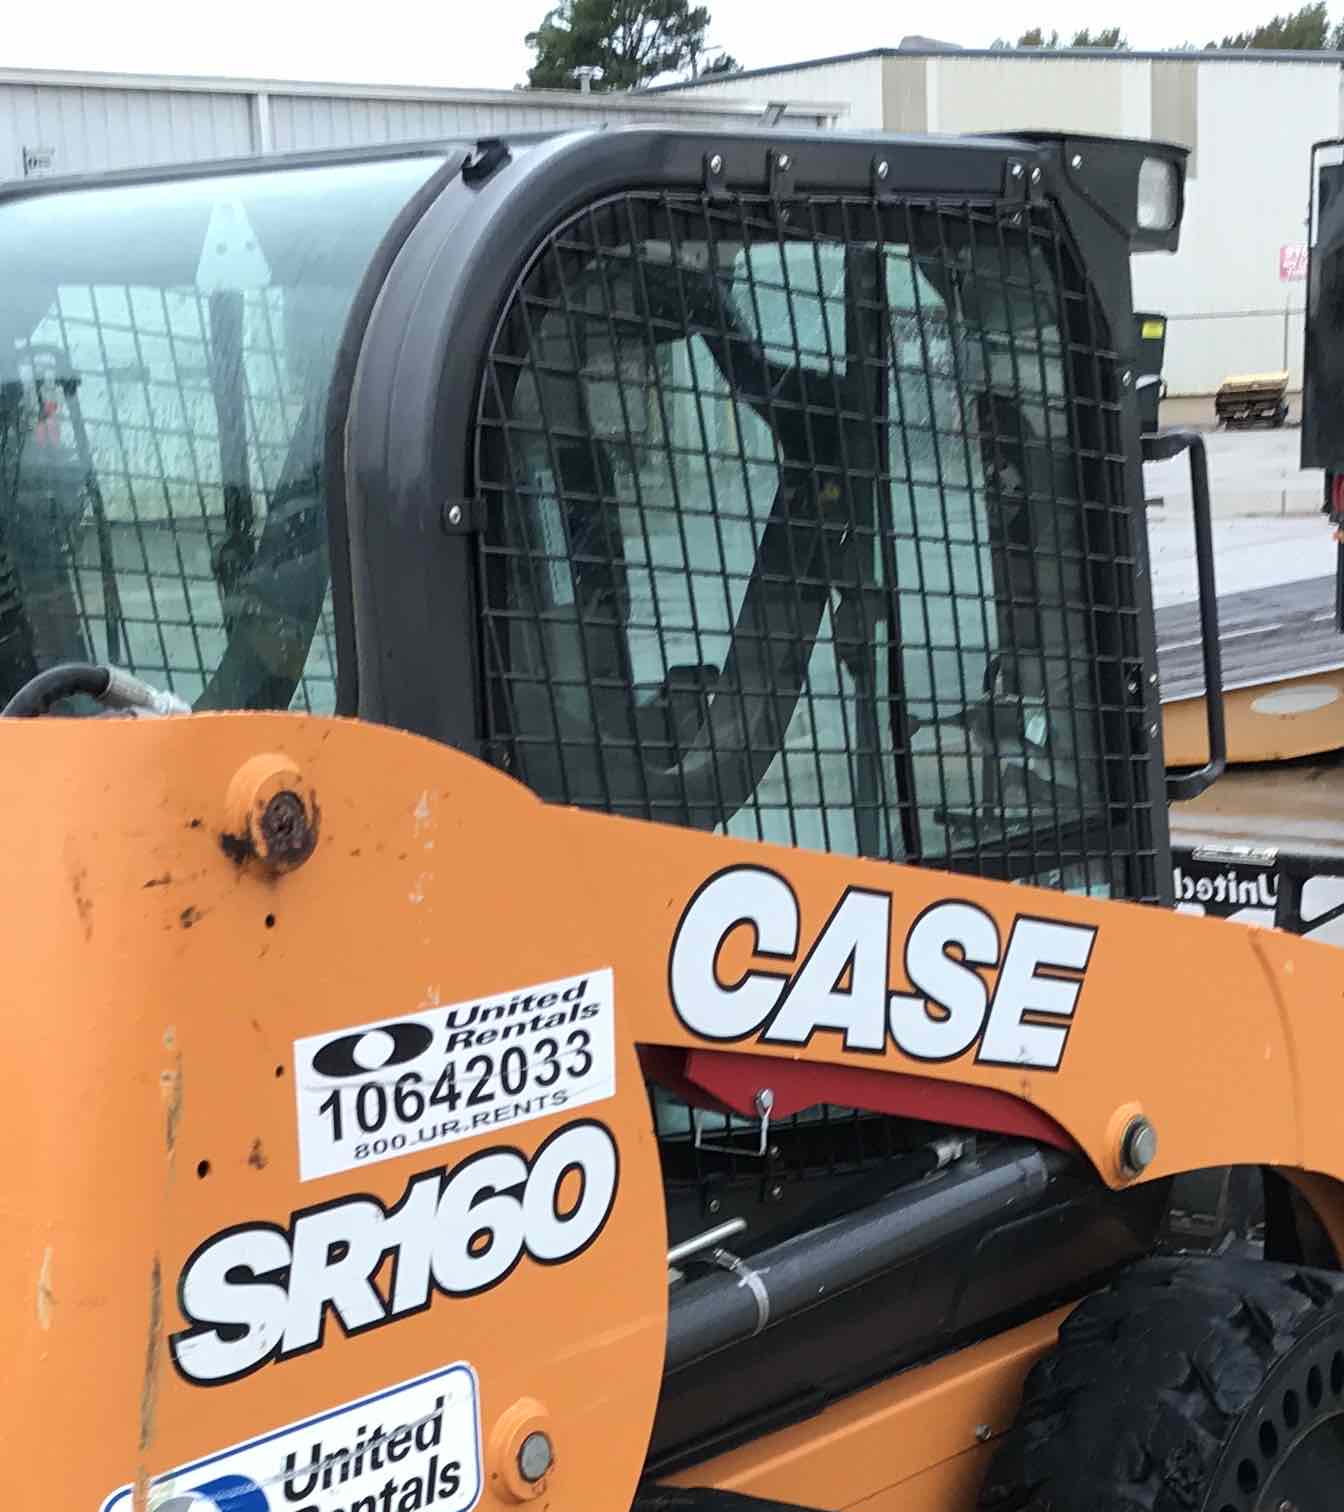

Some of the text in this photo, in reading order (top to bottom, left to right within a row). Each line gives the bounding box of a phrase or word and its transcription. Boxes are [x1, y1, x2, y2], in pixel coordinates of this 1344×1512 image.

[445, 979, 589, 1030] United
[667, 863, 1099, 1073] CASE
[445, 1002, 600, 1054] Rentals
[318, 1029, 594, 1143] 10642033
[168, 1117, 620, 1386] SR160
[283, 1395, 449, 1503] United
